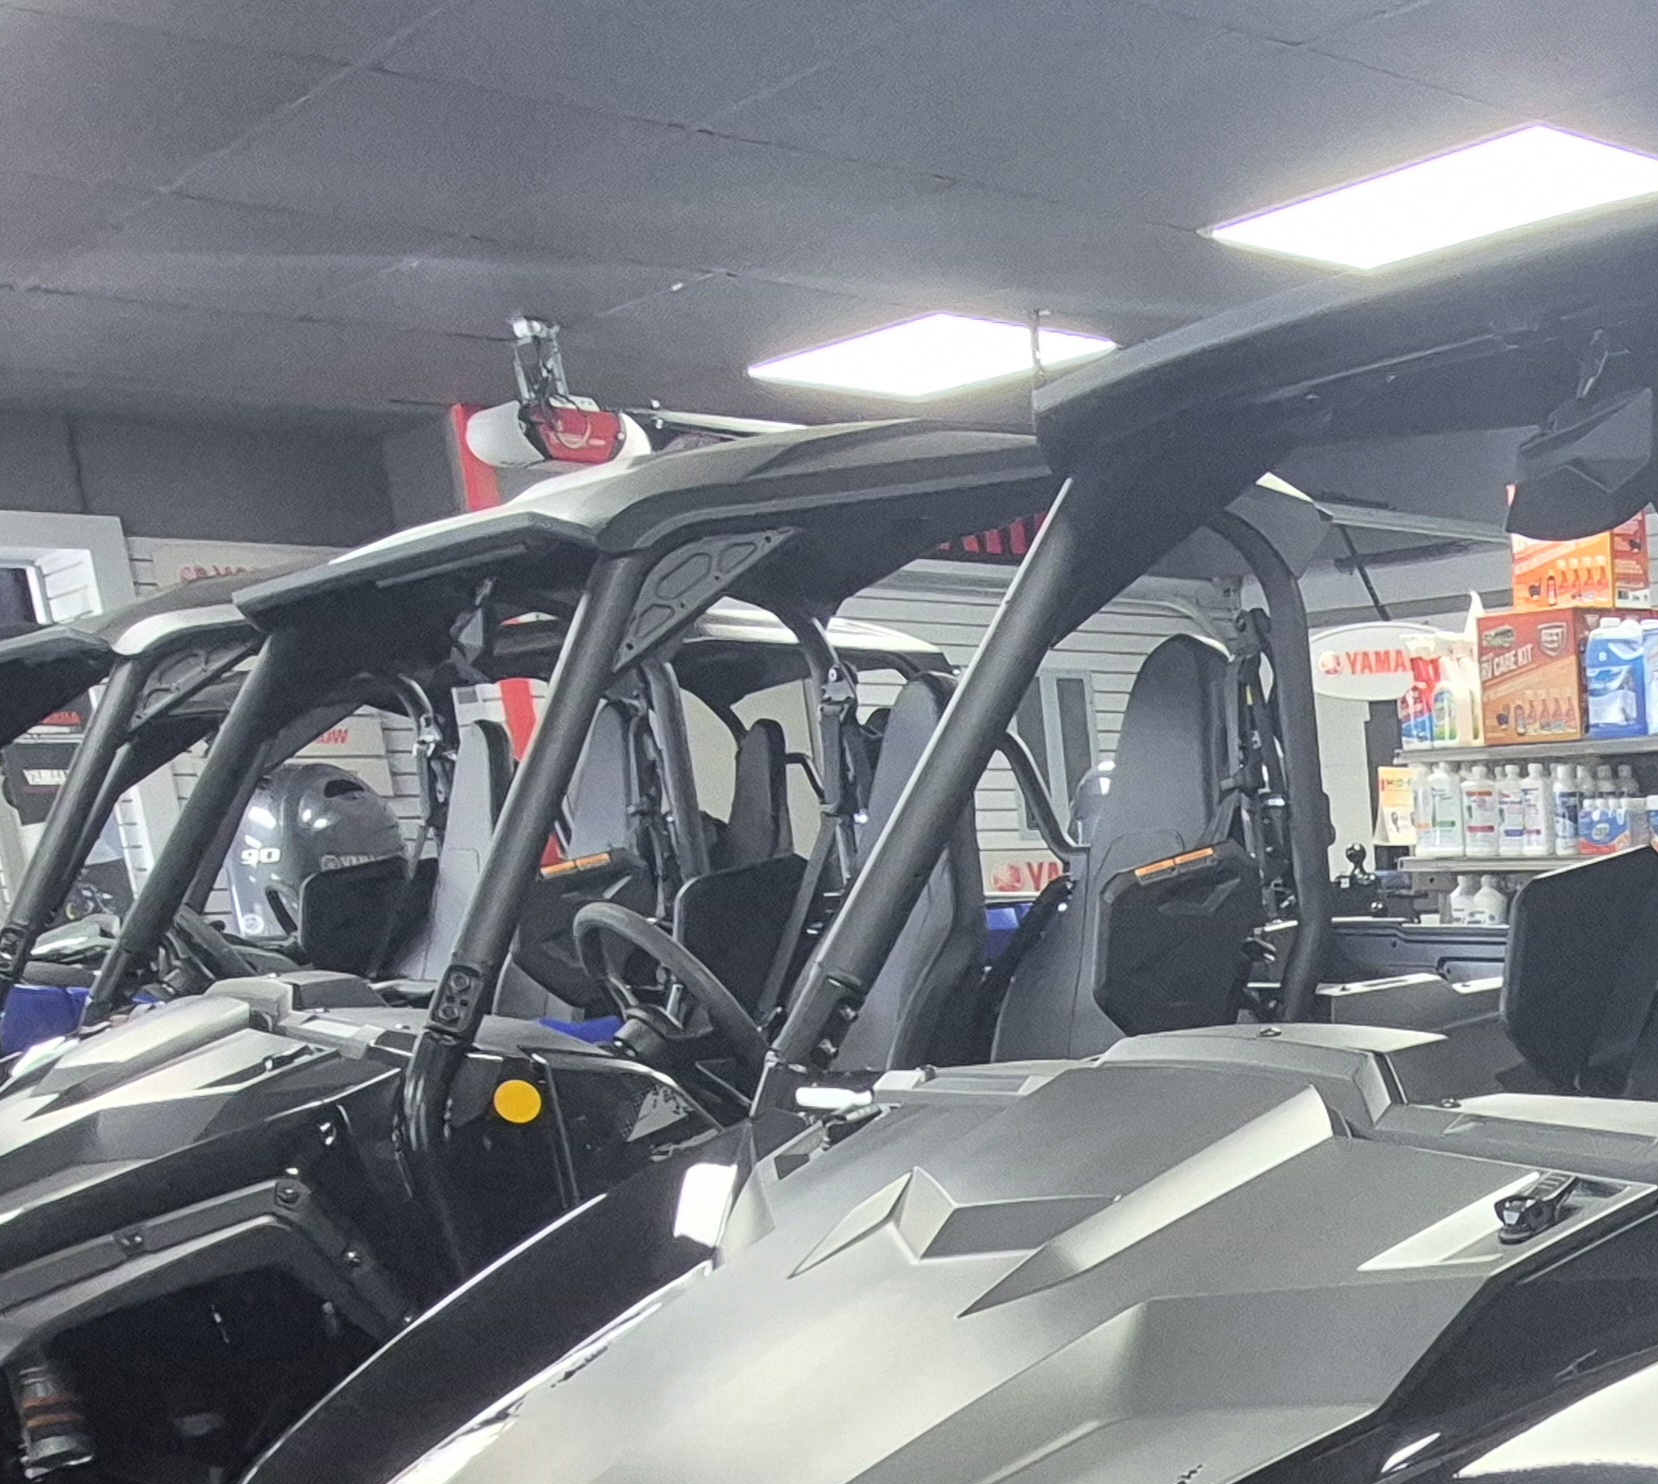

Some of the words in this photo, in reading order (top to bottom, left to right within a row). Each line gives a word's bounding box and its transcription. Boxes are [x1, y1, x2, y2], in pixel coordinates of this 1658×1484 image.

[1346, 650, 1412, 675] YAMA
[1493, 650, 1518, 677] CARE
[1517, 643, 1535, 666] KIT
